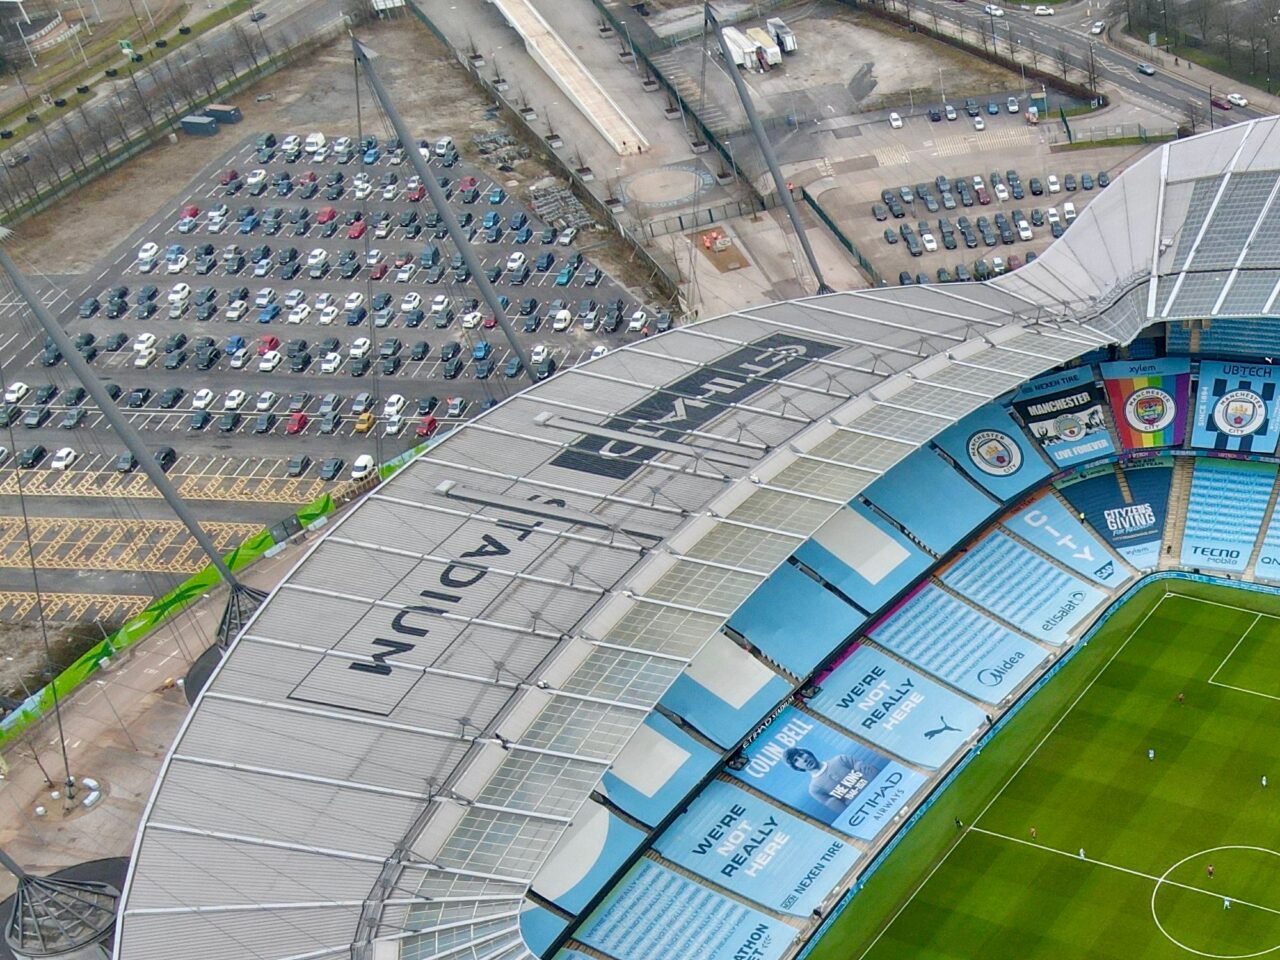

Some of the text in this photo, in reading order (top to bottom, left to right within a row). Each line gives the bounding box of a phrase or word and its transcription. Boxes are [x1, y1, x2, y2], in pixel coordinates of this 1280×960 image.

[1060, 374, 1079, 385] TIRE
[1129, 364, 1156, 374] xylem
[599, 344, 809, 459] ETIHAD
[1027, 391, 1091, 416] MANCHESTER
[1129, 389, 1171, 406] MANCHESTER
[1220, 392, 1263, 409] MANCHESTER
[1198, 404, 1207, 426] SINCE
[971, 432, 1005, 457] MANCHESTER
[1053, 439, 1110, 460] LIVE FOREVER
[1103, 503, 1153, 520] CITYZENS
[1106, 512, 1156, 530] GIVING
[1191, 545, 1241, 558] TECNO
[1096, 565, 1113, 579] SAP
[1042, 599, 1079, 632] etisalat
[977, 651, 1025, 687] Midea
[836, 665, 886, 710] WE'RE
[857, 679, 893, 712] NOT
[861, 677, 915, 729] REALLY
[742, 695, 795, 750] ETIHAD STADIUM
[881, 692, 926, 732] HERE
[745, 717, 814, 779] COLIN BELL
[829, 769, 863, 799] THE KING
[848, 771, 903, 827] ETIHAD
[872, 787, 906, 822] AIRWAYS
[692, 803, 746, 856] WE'RE
[715, 819, 753, 857] NOT
[721, 815, 779, 878] REALLY
[744, 830, 790, 878] HERE
[793, 862, 826, 895] NEXEN
[820, 840, 844, 864] TIRE
